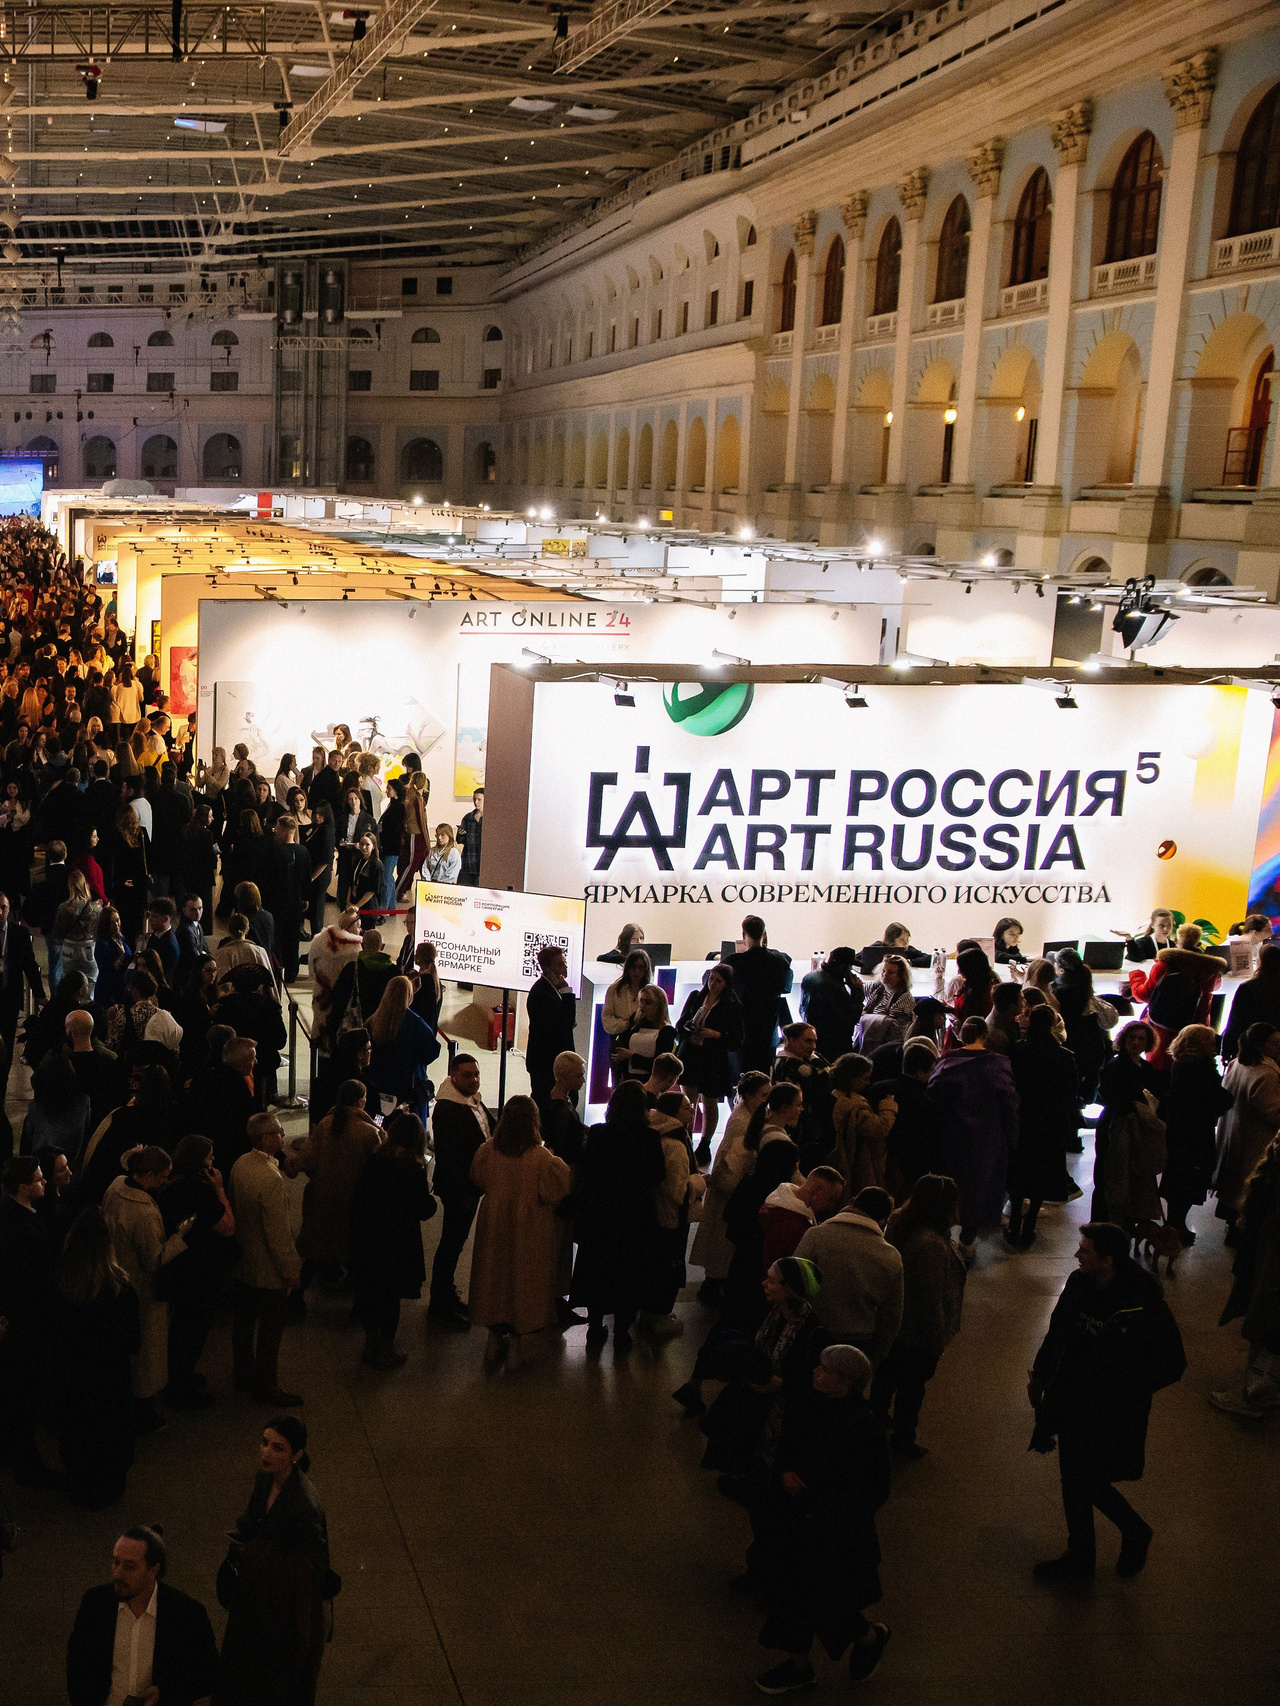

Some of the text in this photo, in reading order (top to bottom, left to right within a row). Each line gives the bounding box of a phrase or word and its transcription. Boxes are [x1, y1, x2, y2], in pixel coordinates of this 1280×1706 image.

[460, 611, 631, 628] ART ONLINE 24
[696, 768, 836, 817] АРТ
[846, 768, 1127, 818] РОССИЯ
[692, 823, 1086, 872] ART RUSSIA
[583, 884, 1112, 904] ЯРМАРКА СОВРЕМЕННОГО ИСКУССТВА
[423, 929, 446, 940] ВАШ
[437, 959, 482, 973] ЯРМАРКЕ
